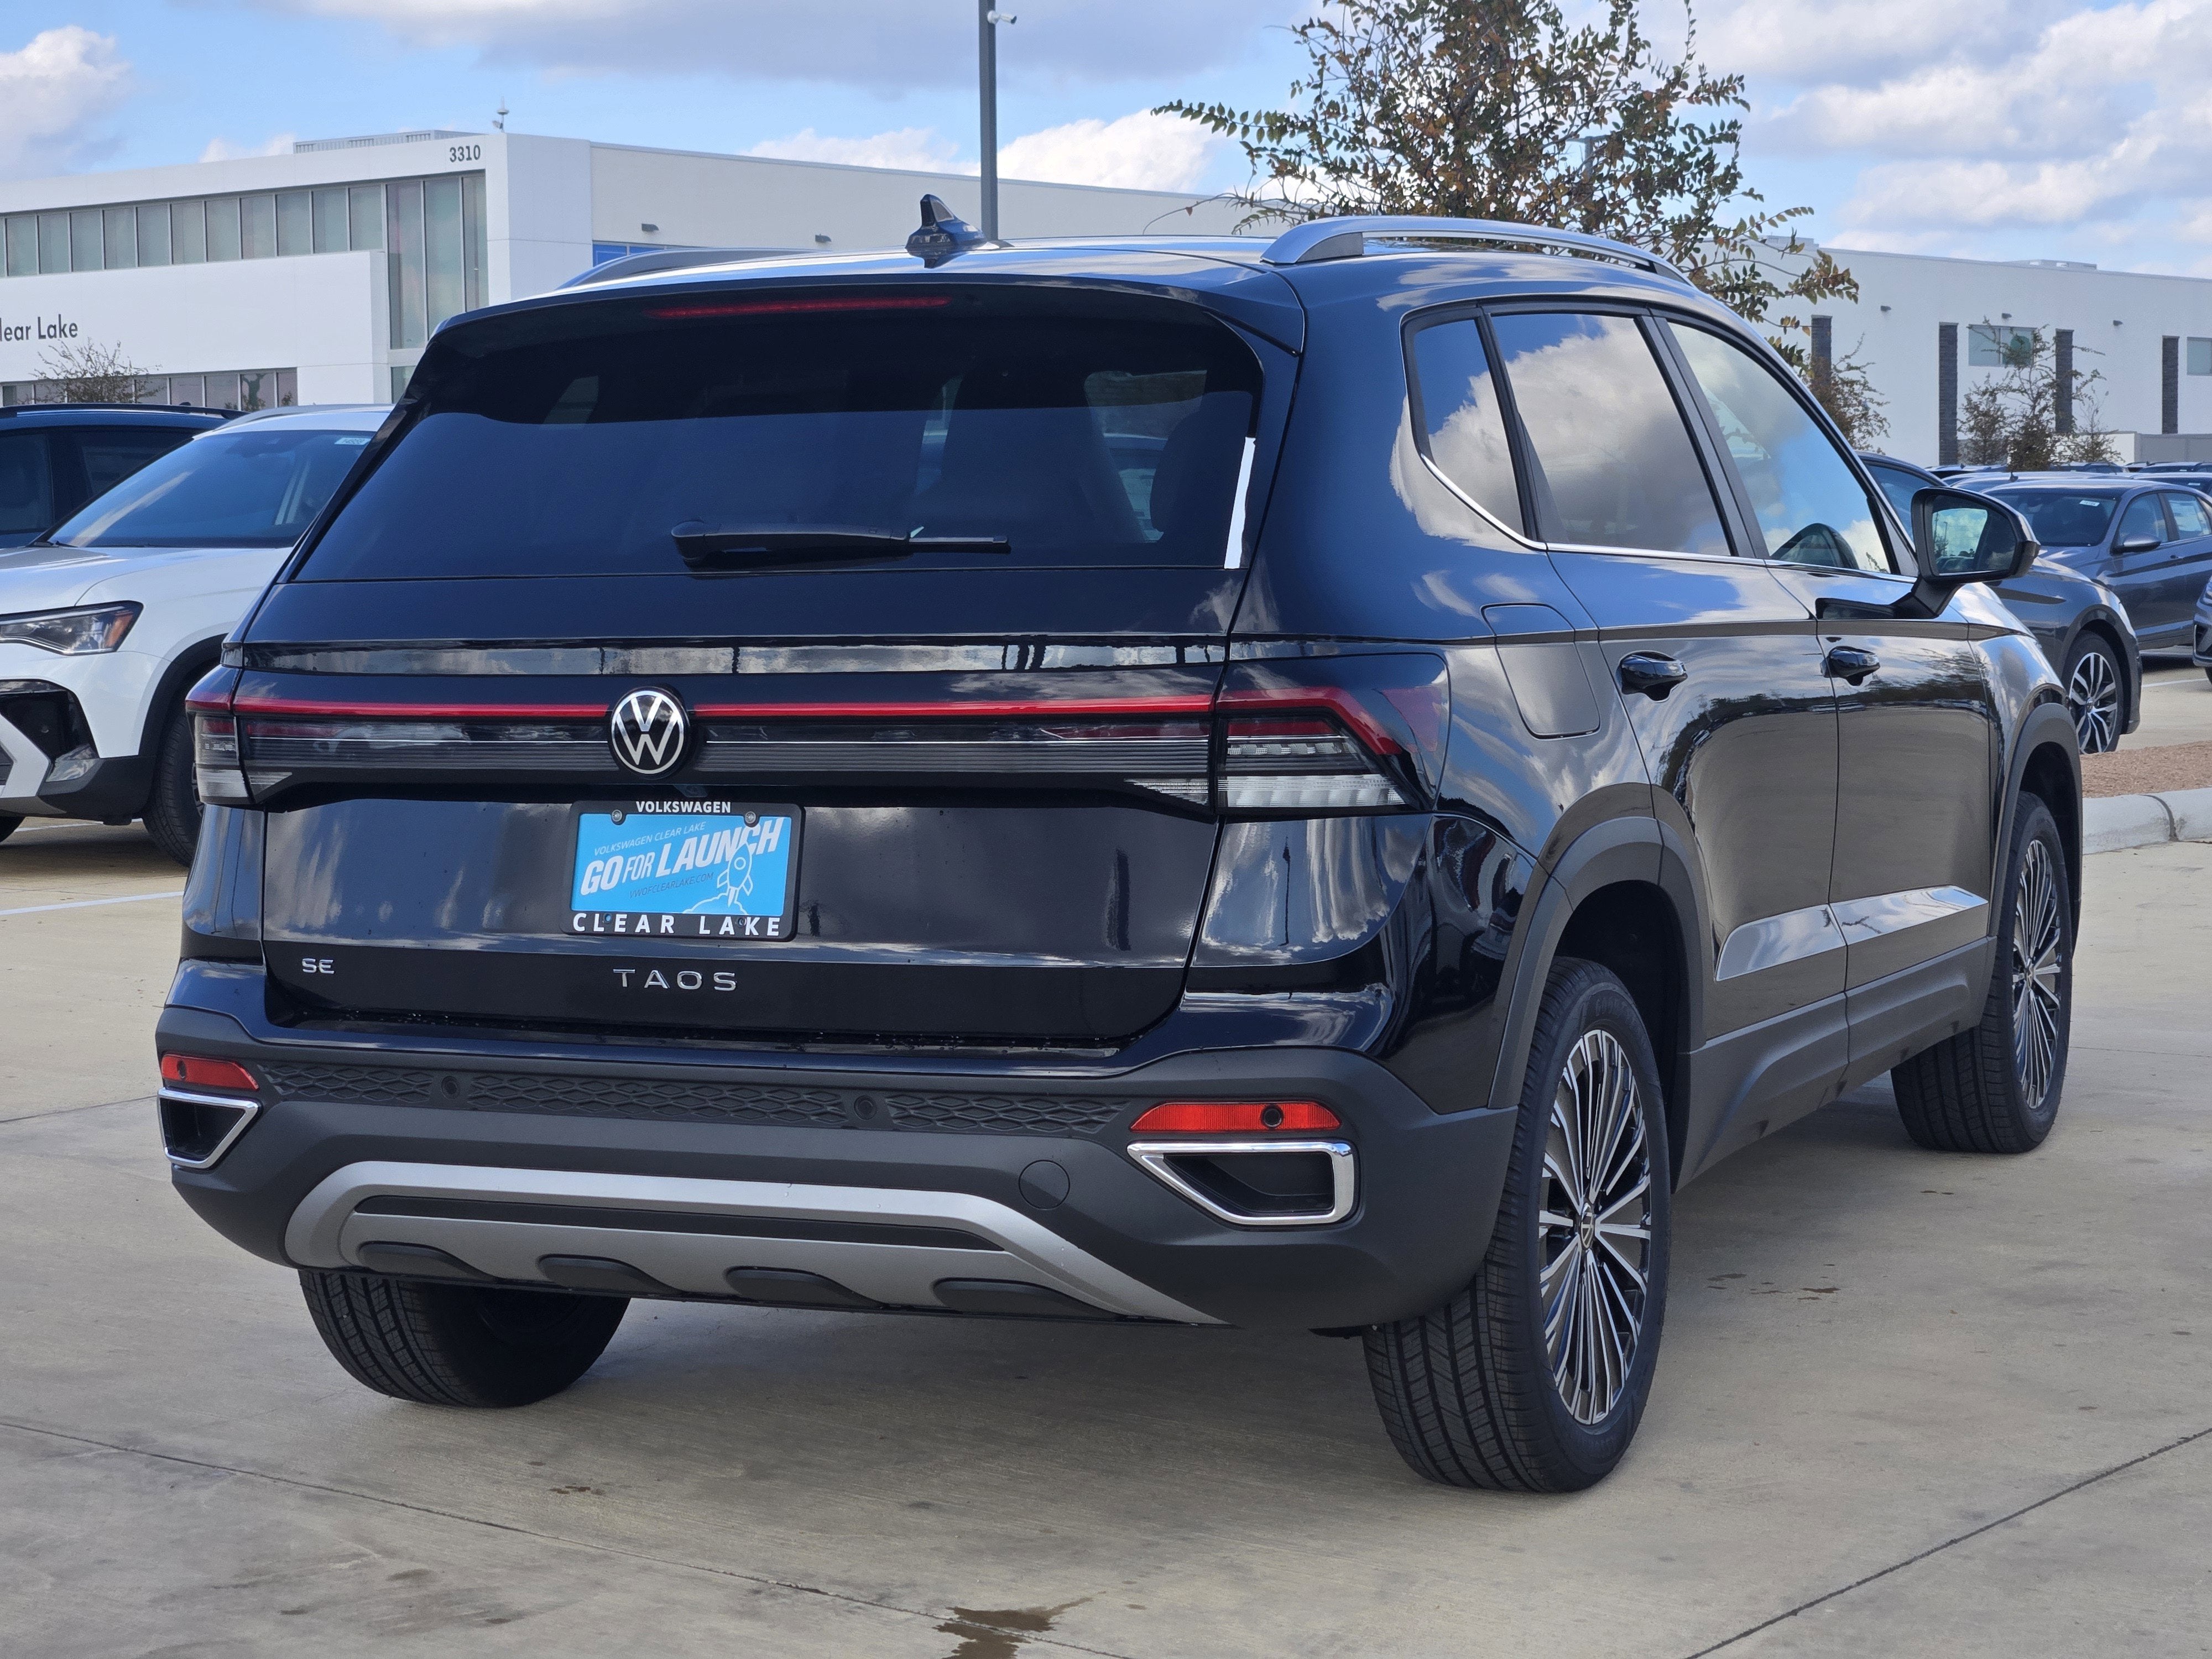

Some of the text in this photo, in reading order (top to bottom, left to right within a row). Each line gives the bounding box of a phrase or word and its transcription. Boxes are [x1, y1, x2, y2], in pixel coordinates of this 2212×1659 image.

[449, 144, 481, 163] 3310
[38, 314, 78, 340] Lake
[636, 801, 731, 813] VOLKSWAGEN
[594, 821, 707, 857] VOLKSWAGEN CLEAR LAKE
[581, 817, 784, 895] GO FOR LAUNCH
[629, 872, 714, 898] VWOFCLEARLAKE.COM
[573, 913, 780, 936] CLEAR LAKE
[302, 958, 335, 974] SE
[613, 969, 737, 992] TAOS
